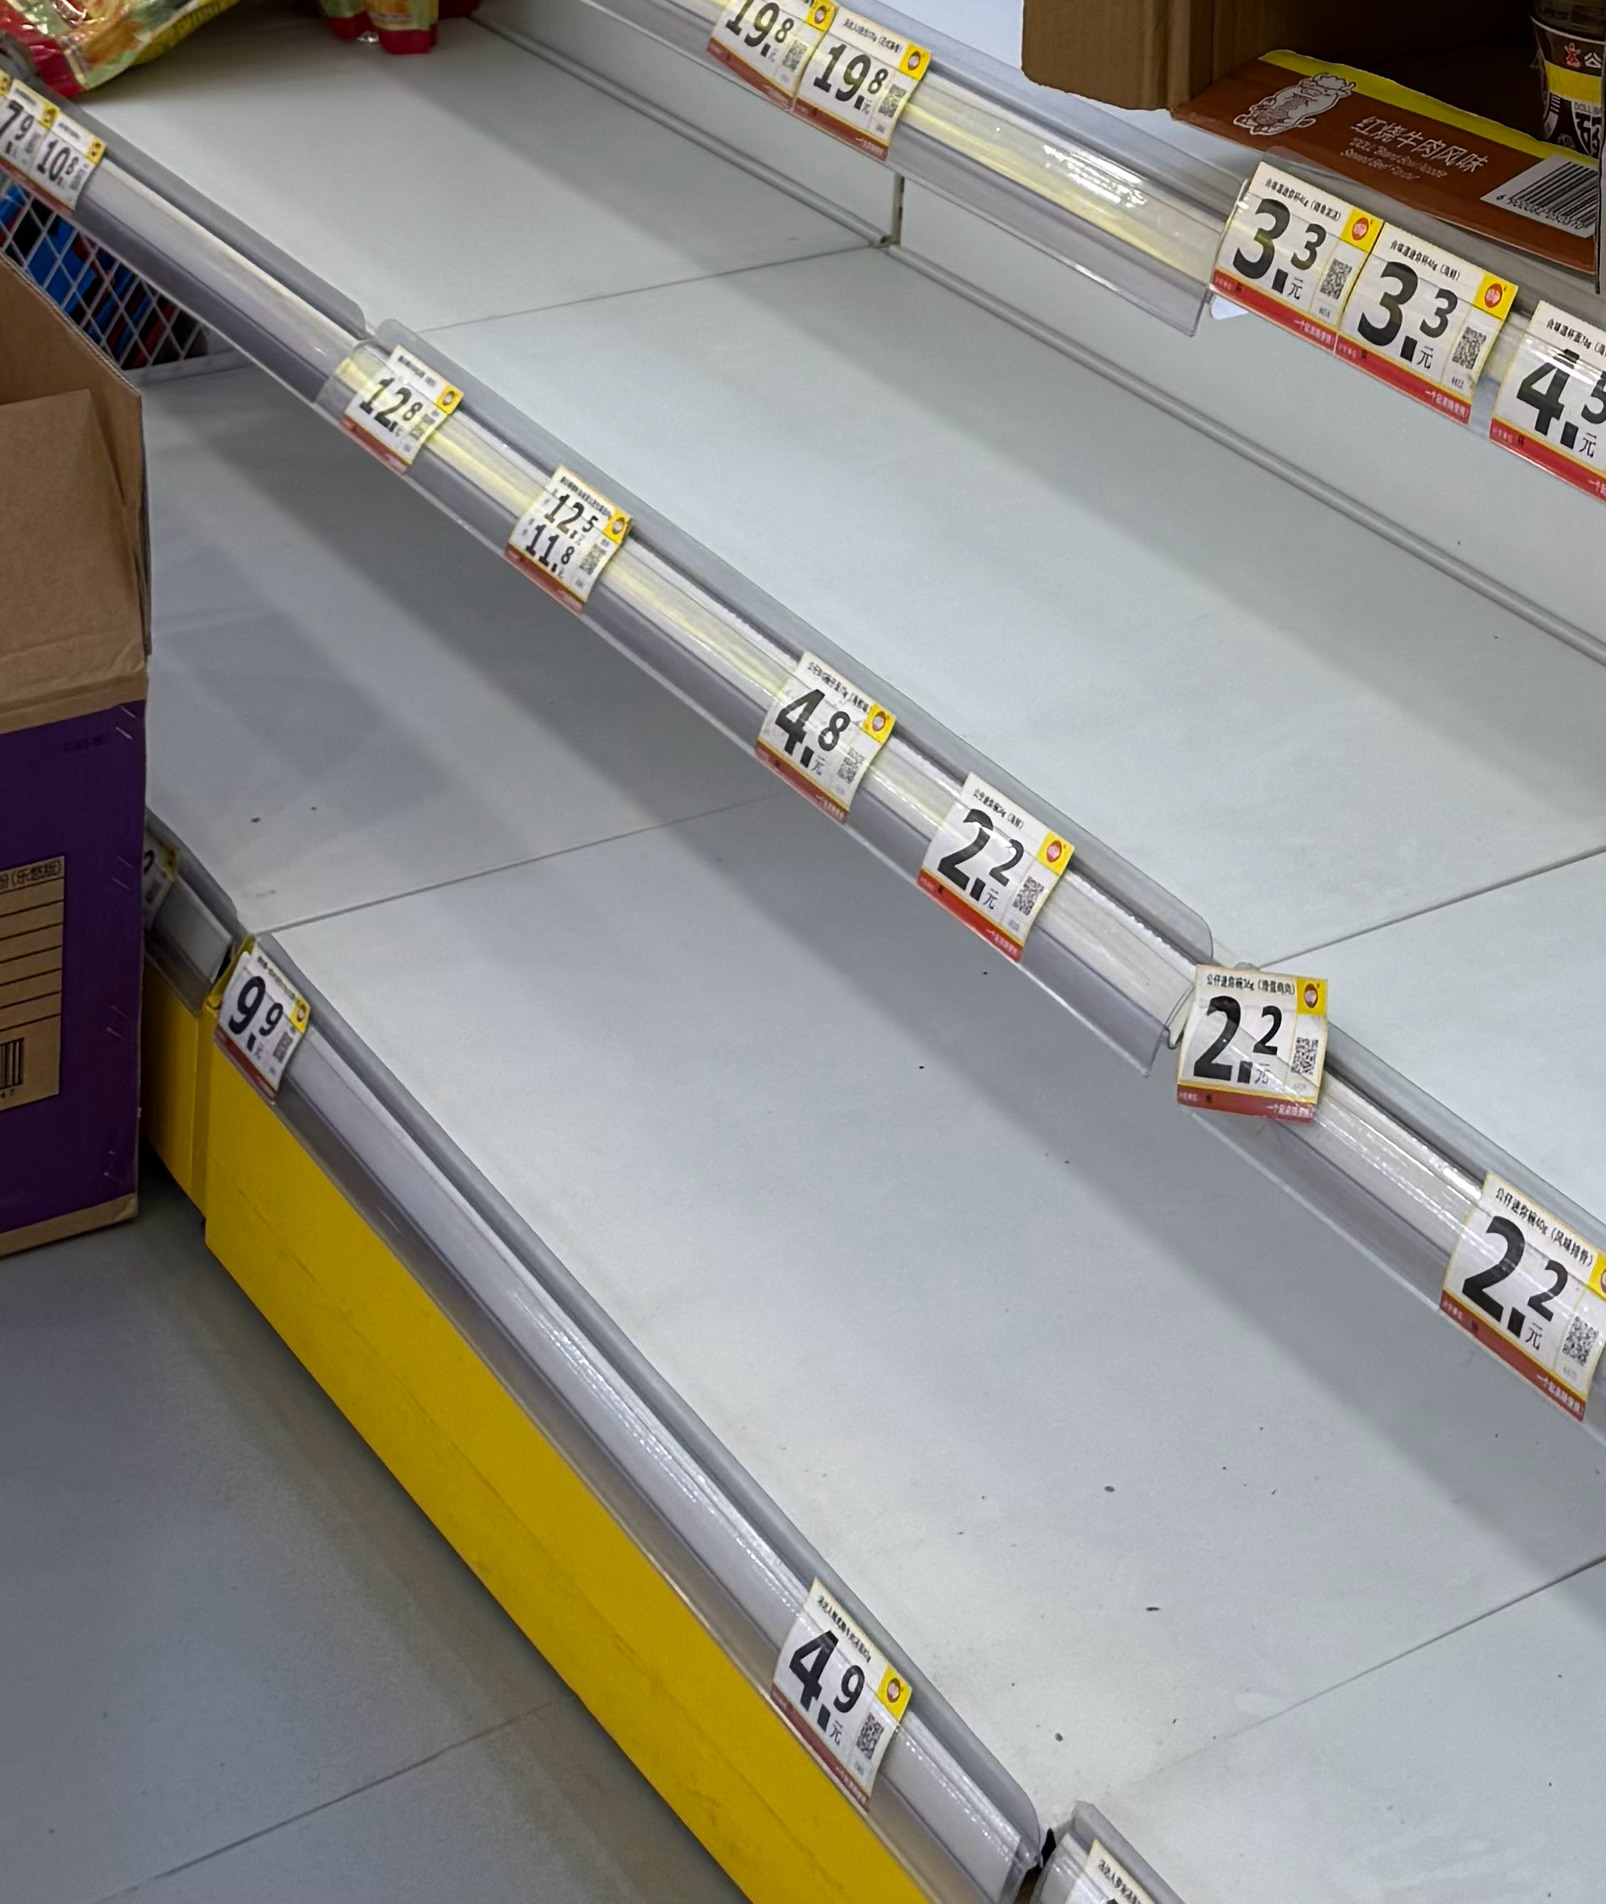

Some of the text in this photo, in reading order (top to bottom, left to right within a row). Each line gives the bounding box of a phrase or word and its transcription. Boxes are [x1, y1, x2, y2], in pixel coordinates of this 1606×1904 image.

[813, 42, 889, 110] 19.8
[1349, 116, 1489, 174] 红烧牛肉风味
[1231, 197, 1327, 294] 3.3
[1289, 278, 1301, 301] 元
[1356, 260, 1458, 363] 3.3
[1417, 346, 1434, 369] 元
[359, 376, 424, 434] 12.8
[1578, 435, 1597, 459] 元
[525, 523, 575, 574] 11.8
[543, 493, 600, 540] 12.5
[774, 688, 851, 769] 4.8
[936, 807, 1025, 902] 2.2
[982, 889, 998, 912] 元
[228, 975, 285, 1051] 9.9
[1193, 995, 1282, 1085] 2.2 元
[1461, 1214, 1569, 1352] 2.2 元
[788, 1628, 868, 1731] 4.9
[828, 1720, 843, 1747] 元
